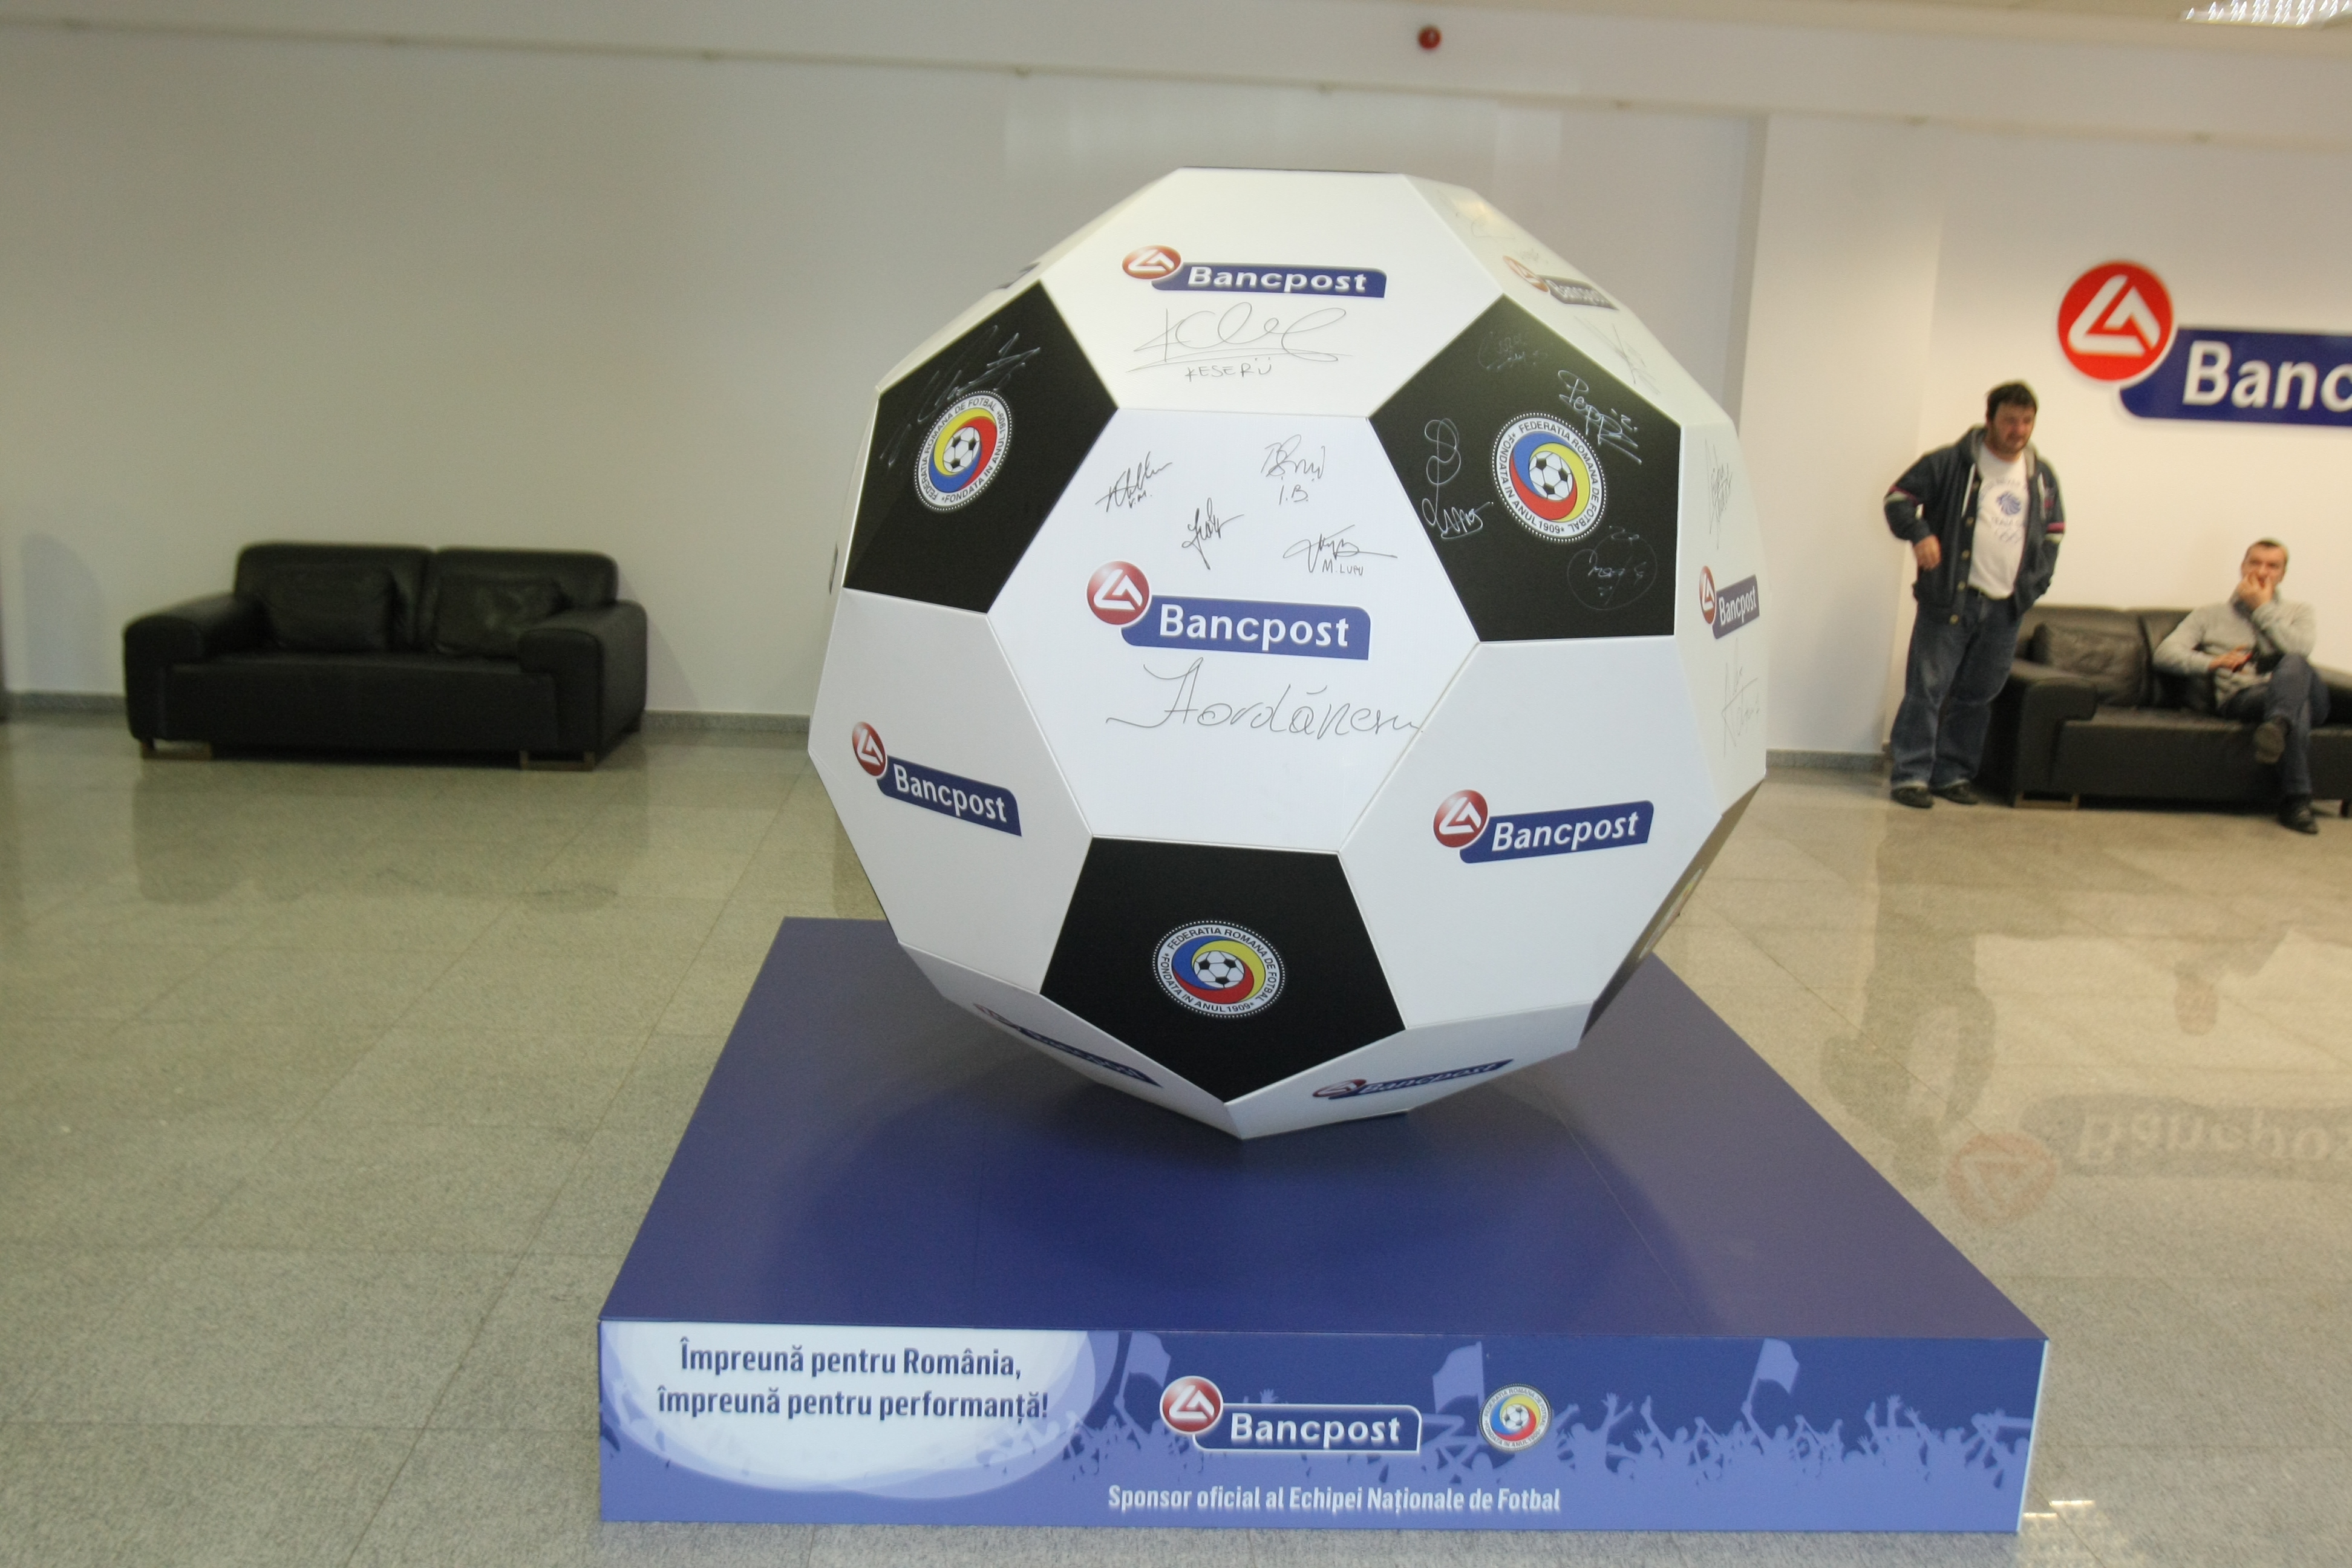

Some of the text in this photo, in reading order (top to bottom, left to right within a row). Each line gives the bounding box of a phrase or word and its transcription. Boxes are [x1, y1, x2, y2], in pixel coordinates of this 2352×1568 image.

[1187, 266, 1367, 293] Bancpost
[2182, 340, 2352, 413] Banc
[921, 397, 997, 500] FEDERATIA ROMANA DE FOTBAL
[984, 466, 994, 477] IN
[992, 434, 1006, 463] ANUL
[1518, 421, 1599, 532] FEDERATIA ROMANA DE FOTBAL
[1504, 486, 1515, 498] IN
[1512, 500, 1537, 526] ANUL
[1719, 586, 1756, 626] Bancpost
[1158, 604, 1349, 651] Bancpost
[893, 763, 1007, 822] Bancpost
[1492, 811, 1638, 851] Bancpost
[1167, 927, 1277, 1002] FEDERATIA ROMANA DE FOTBAL
[1181, 993, 1194, 1003] IN
[1194, 999, 1226, 1012] ANUL
[680, 1336, 1021, 1379] Împreună pentru România,
[658, 1385, 1048, 1424] împreună pentru performanță!
[1229, 1412, 1400, 1449] Bancpost
[1108, 1484, 1561, 1514] Sponsor oficial al Echipei Naționale de Fotbal
